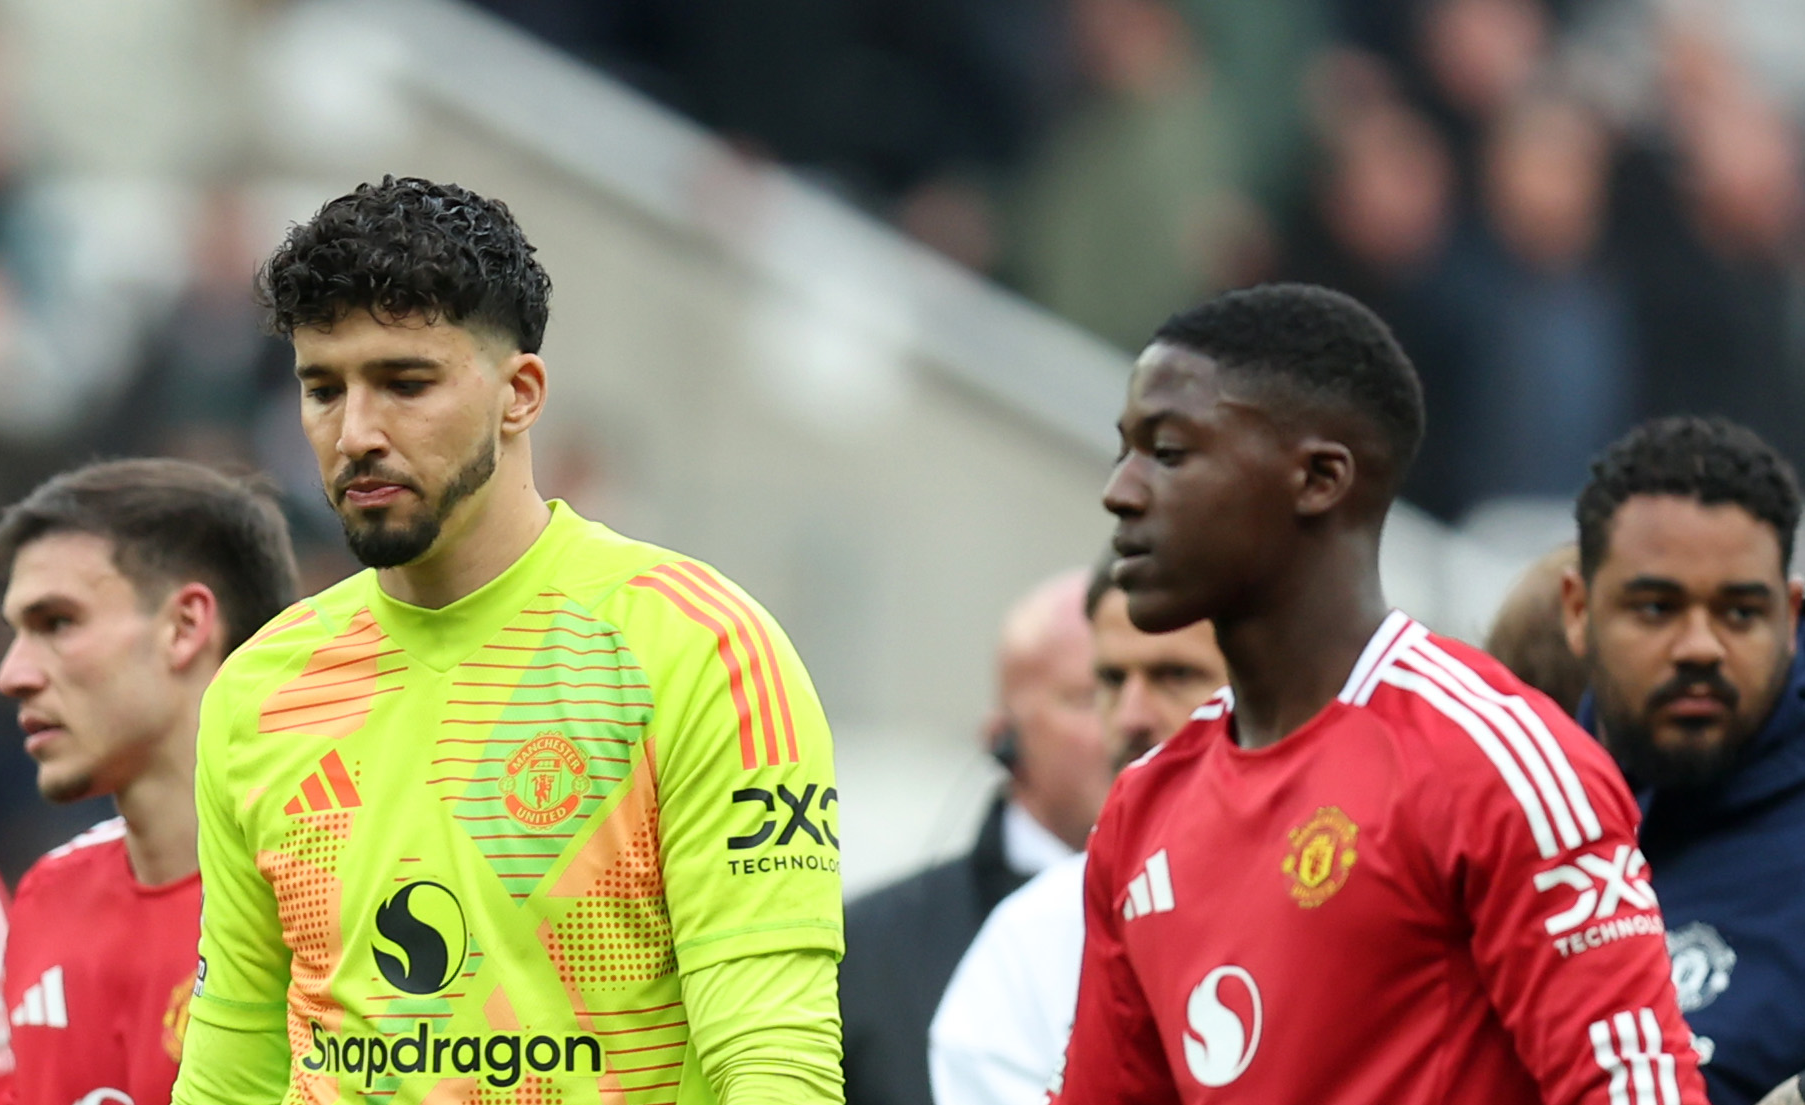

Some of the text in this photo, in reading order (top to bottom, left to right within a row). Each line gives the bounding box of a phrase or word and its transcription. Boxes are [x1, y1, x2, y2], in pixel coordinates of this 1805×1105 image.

[512, 738, 581, 770] MANCHESTER
[516, 806, 567, 824] UNITED
[728, 855, 840, 876] TECHNOLO
[302, 1020, 602, 1088] Snapdragon
